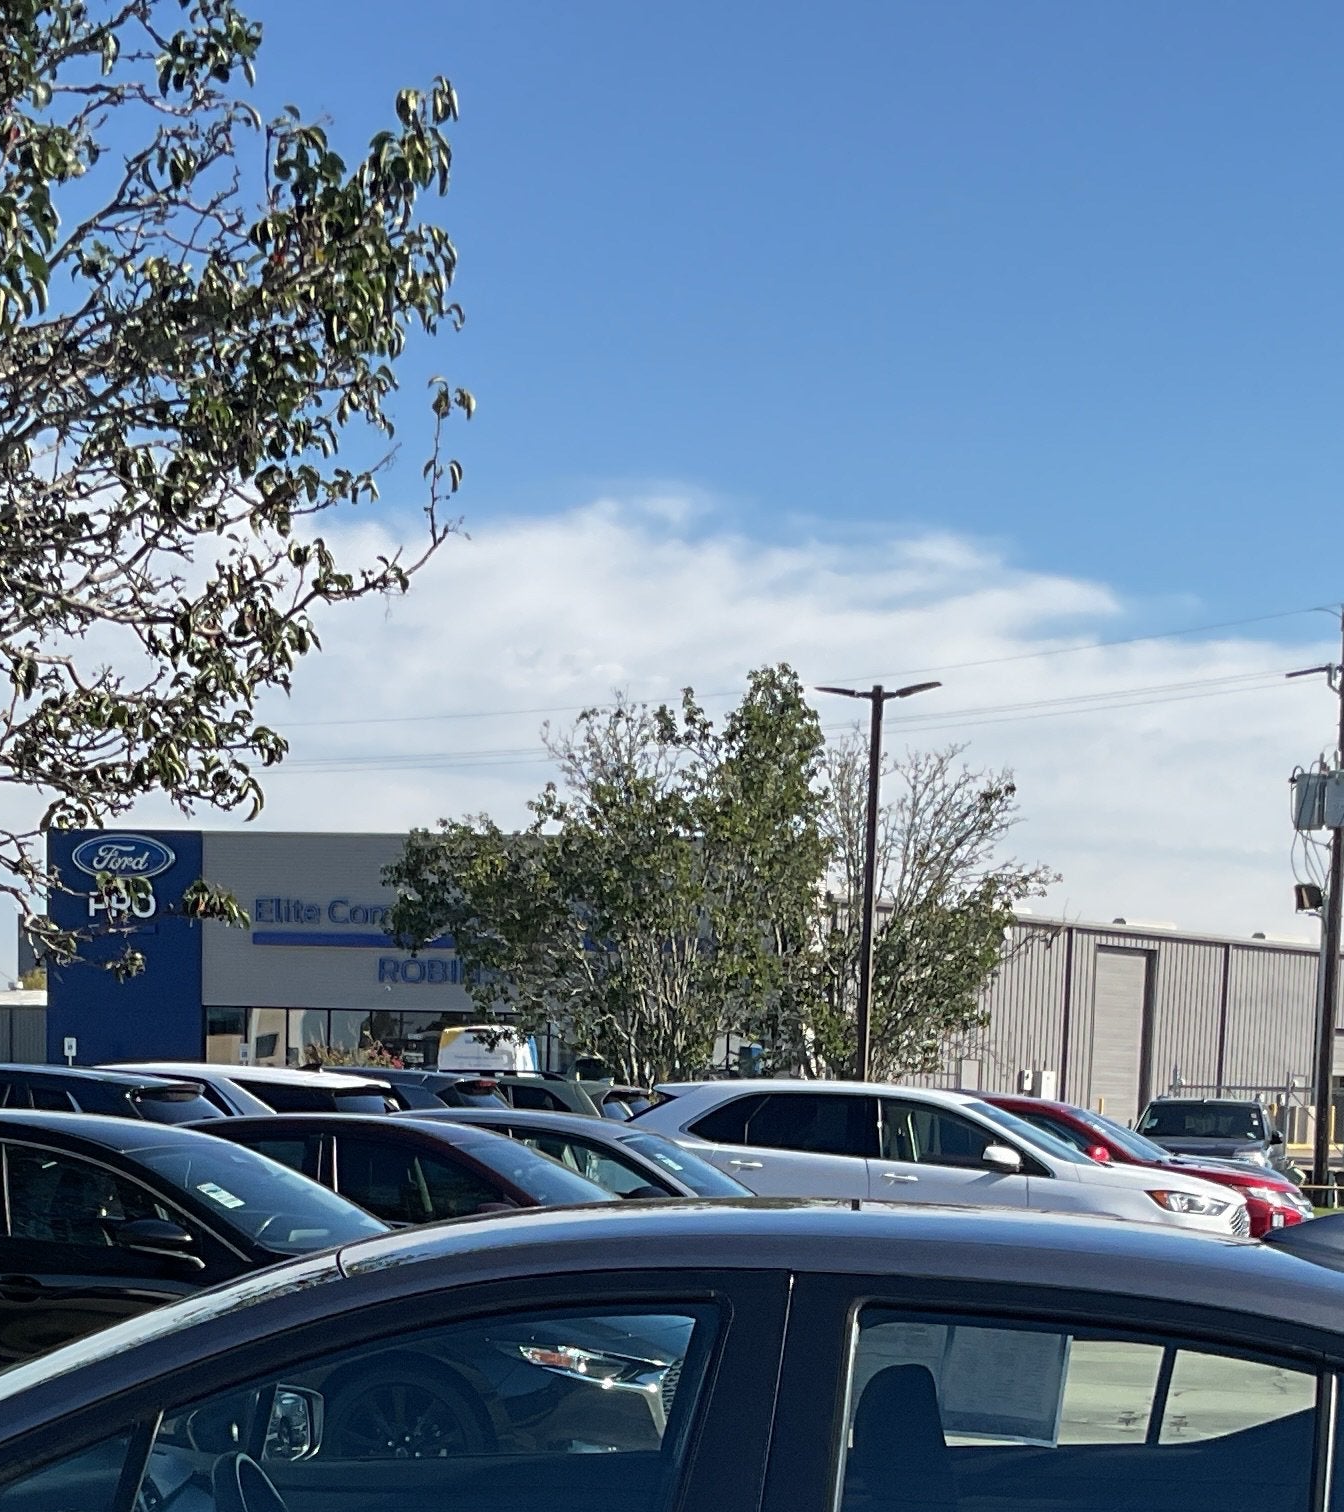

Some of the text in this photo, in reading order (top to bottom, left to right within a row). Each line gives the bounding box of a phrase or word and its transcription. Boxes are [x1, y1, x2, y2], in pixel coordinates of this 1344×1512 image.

[93, 844, 150, 870] Ford
[89, 891, 156, 918] PRO
[255, 898, 321, 924] Elite
